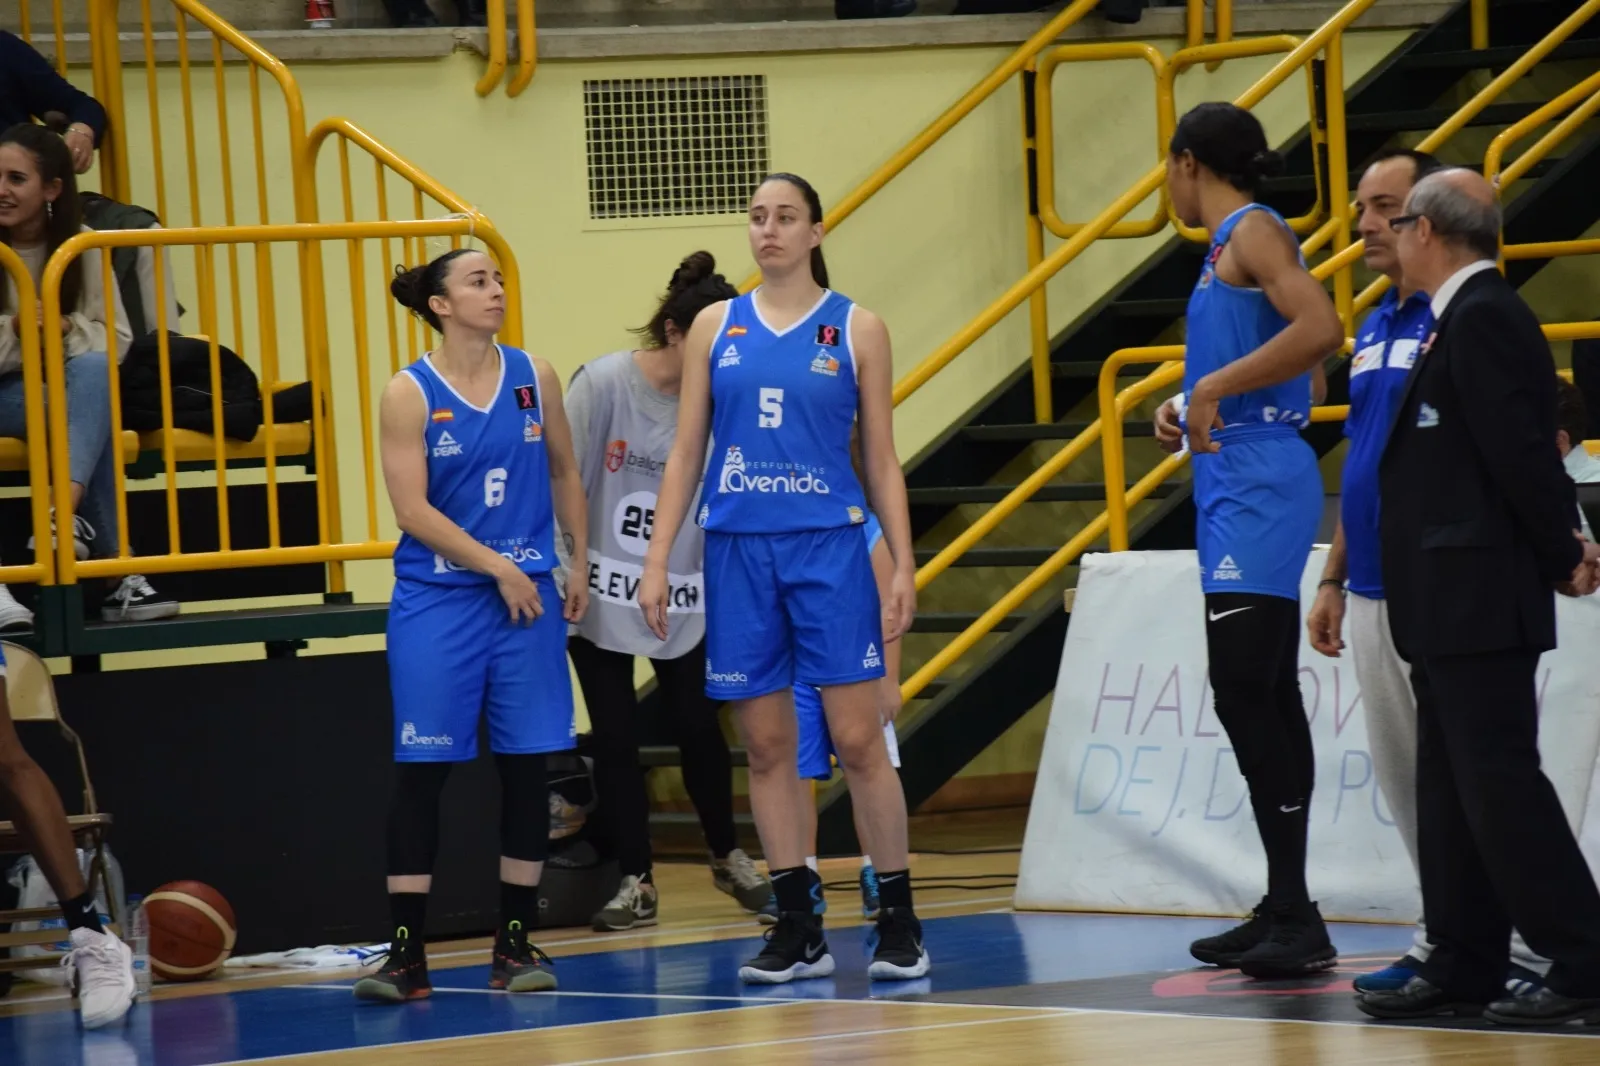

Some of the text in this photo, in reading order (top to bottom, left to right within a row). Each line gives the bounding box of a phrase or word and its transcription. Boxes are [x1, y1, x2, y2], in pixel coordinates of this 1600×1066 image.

[718, 356, 741, 368] PEAK
[758, 387, 784, 429] 5
[433, 444, 463, 457] PEAK
[627, 450, 667, 472] balon
[484, 467, 508, 508] 6
[1212, 569, 1243, 580] PEAK
[863, 657, 882, 669] PEAK
